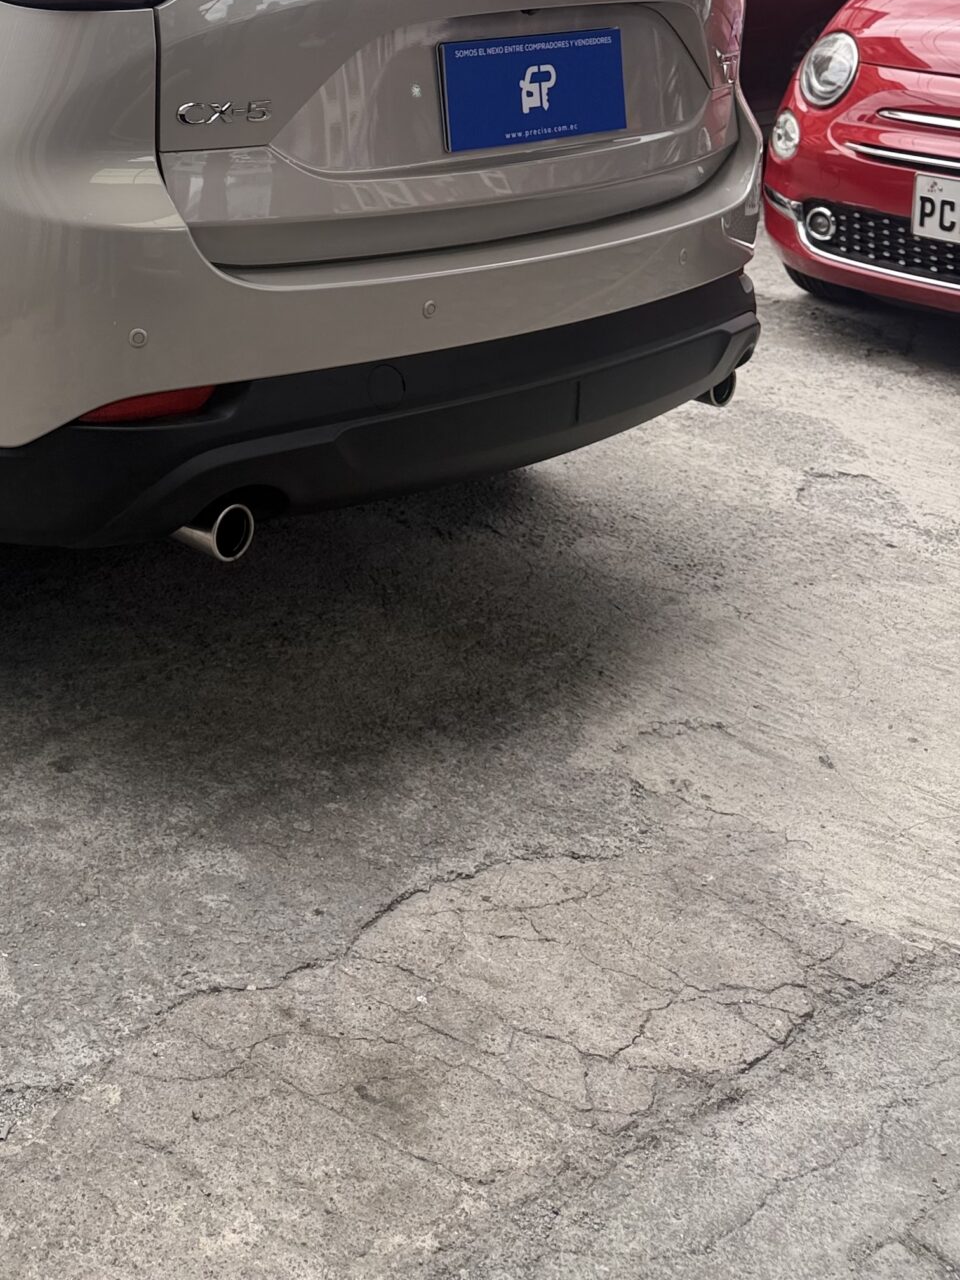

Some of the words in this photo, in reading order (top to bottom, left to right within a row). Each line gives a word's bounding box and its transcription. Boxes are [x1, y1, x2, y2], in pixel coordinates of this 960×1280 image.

[454, 48, 478, 58] SOMOS
[478, 47, 487, 56] EL
[487, 46, 503, 55] NEXO
[504, 44, 524, 54] ENTRE
[524, 39, 570, 52] COMPRADORES
[574, 36, 612, 47] VENDEDORES
[177, 100, 272, 124] CX-5
[919, 195, 957, 232] PC
